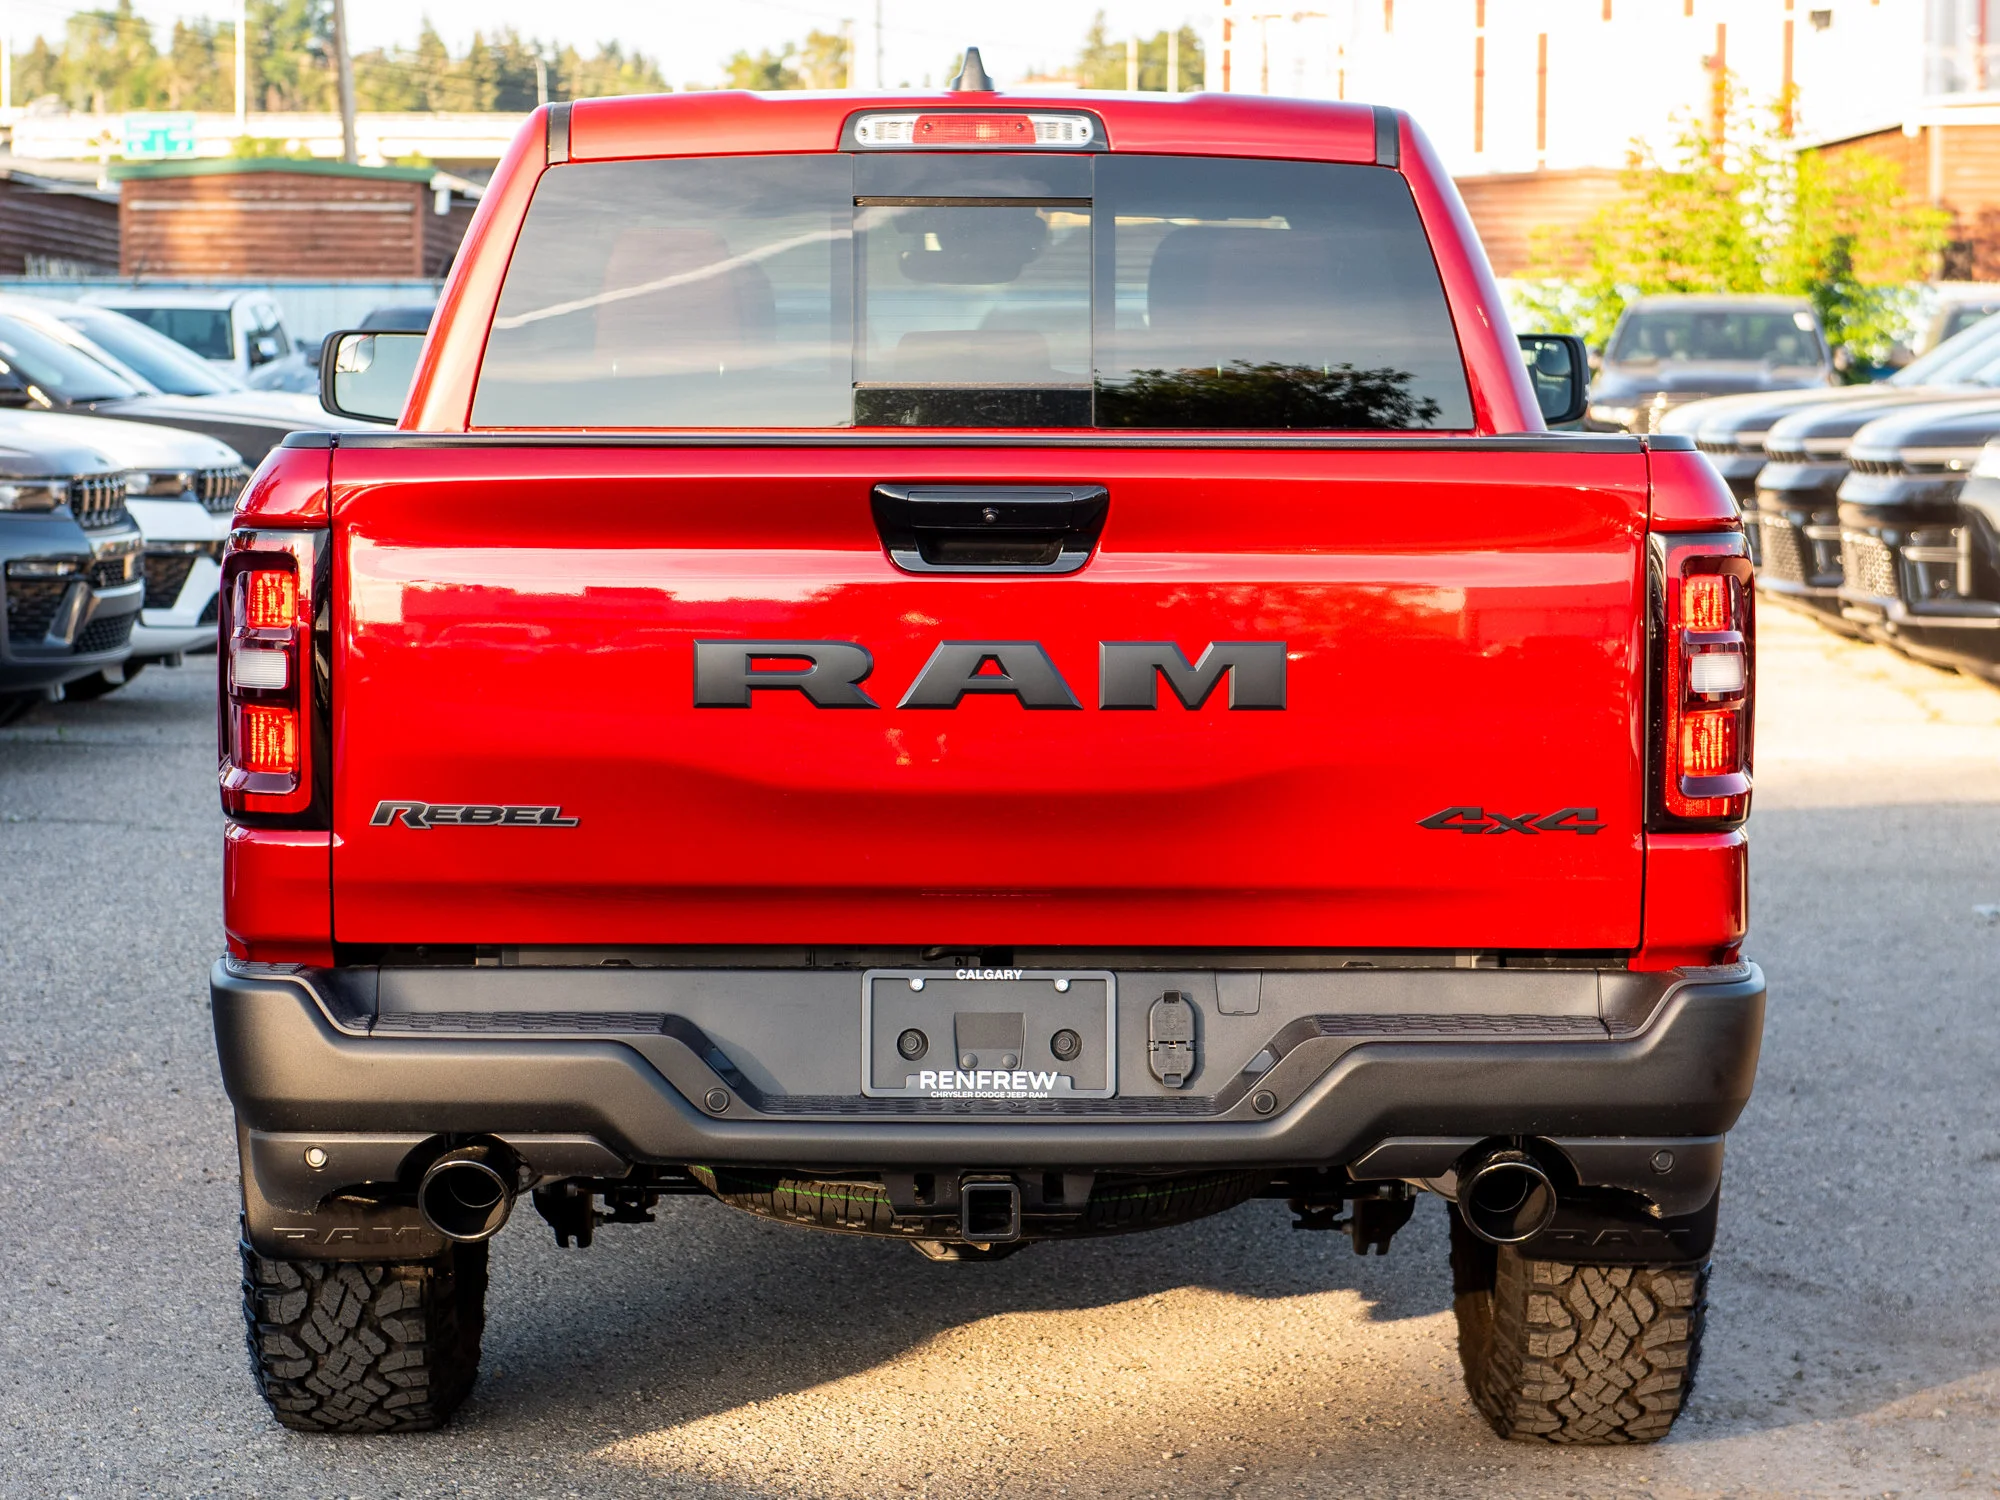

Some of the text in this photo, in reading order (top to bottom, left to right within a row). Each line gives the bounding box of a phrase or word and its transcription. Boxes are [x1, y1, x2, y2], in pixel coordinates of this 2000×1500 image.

[693, 638, 1287, 710] RAM
[368, 799, 580, 830] REBEL
[1415, 806, 1608, 835] 4x4
[955, 969, 1023, 980] CALGARY
[919, 1070, 1058, 1090] RENFREW
[930, 1090, 1048, 1099] CHRYSLER DODGE JEEP RAM
[272, 1226, 422, 1246] RAM
